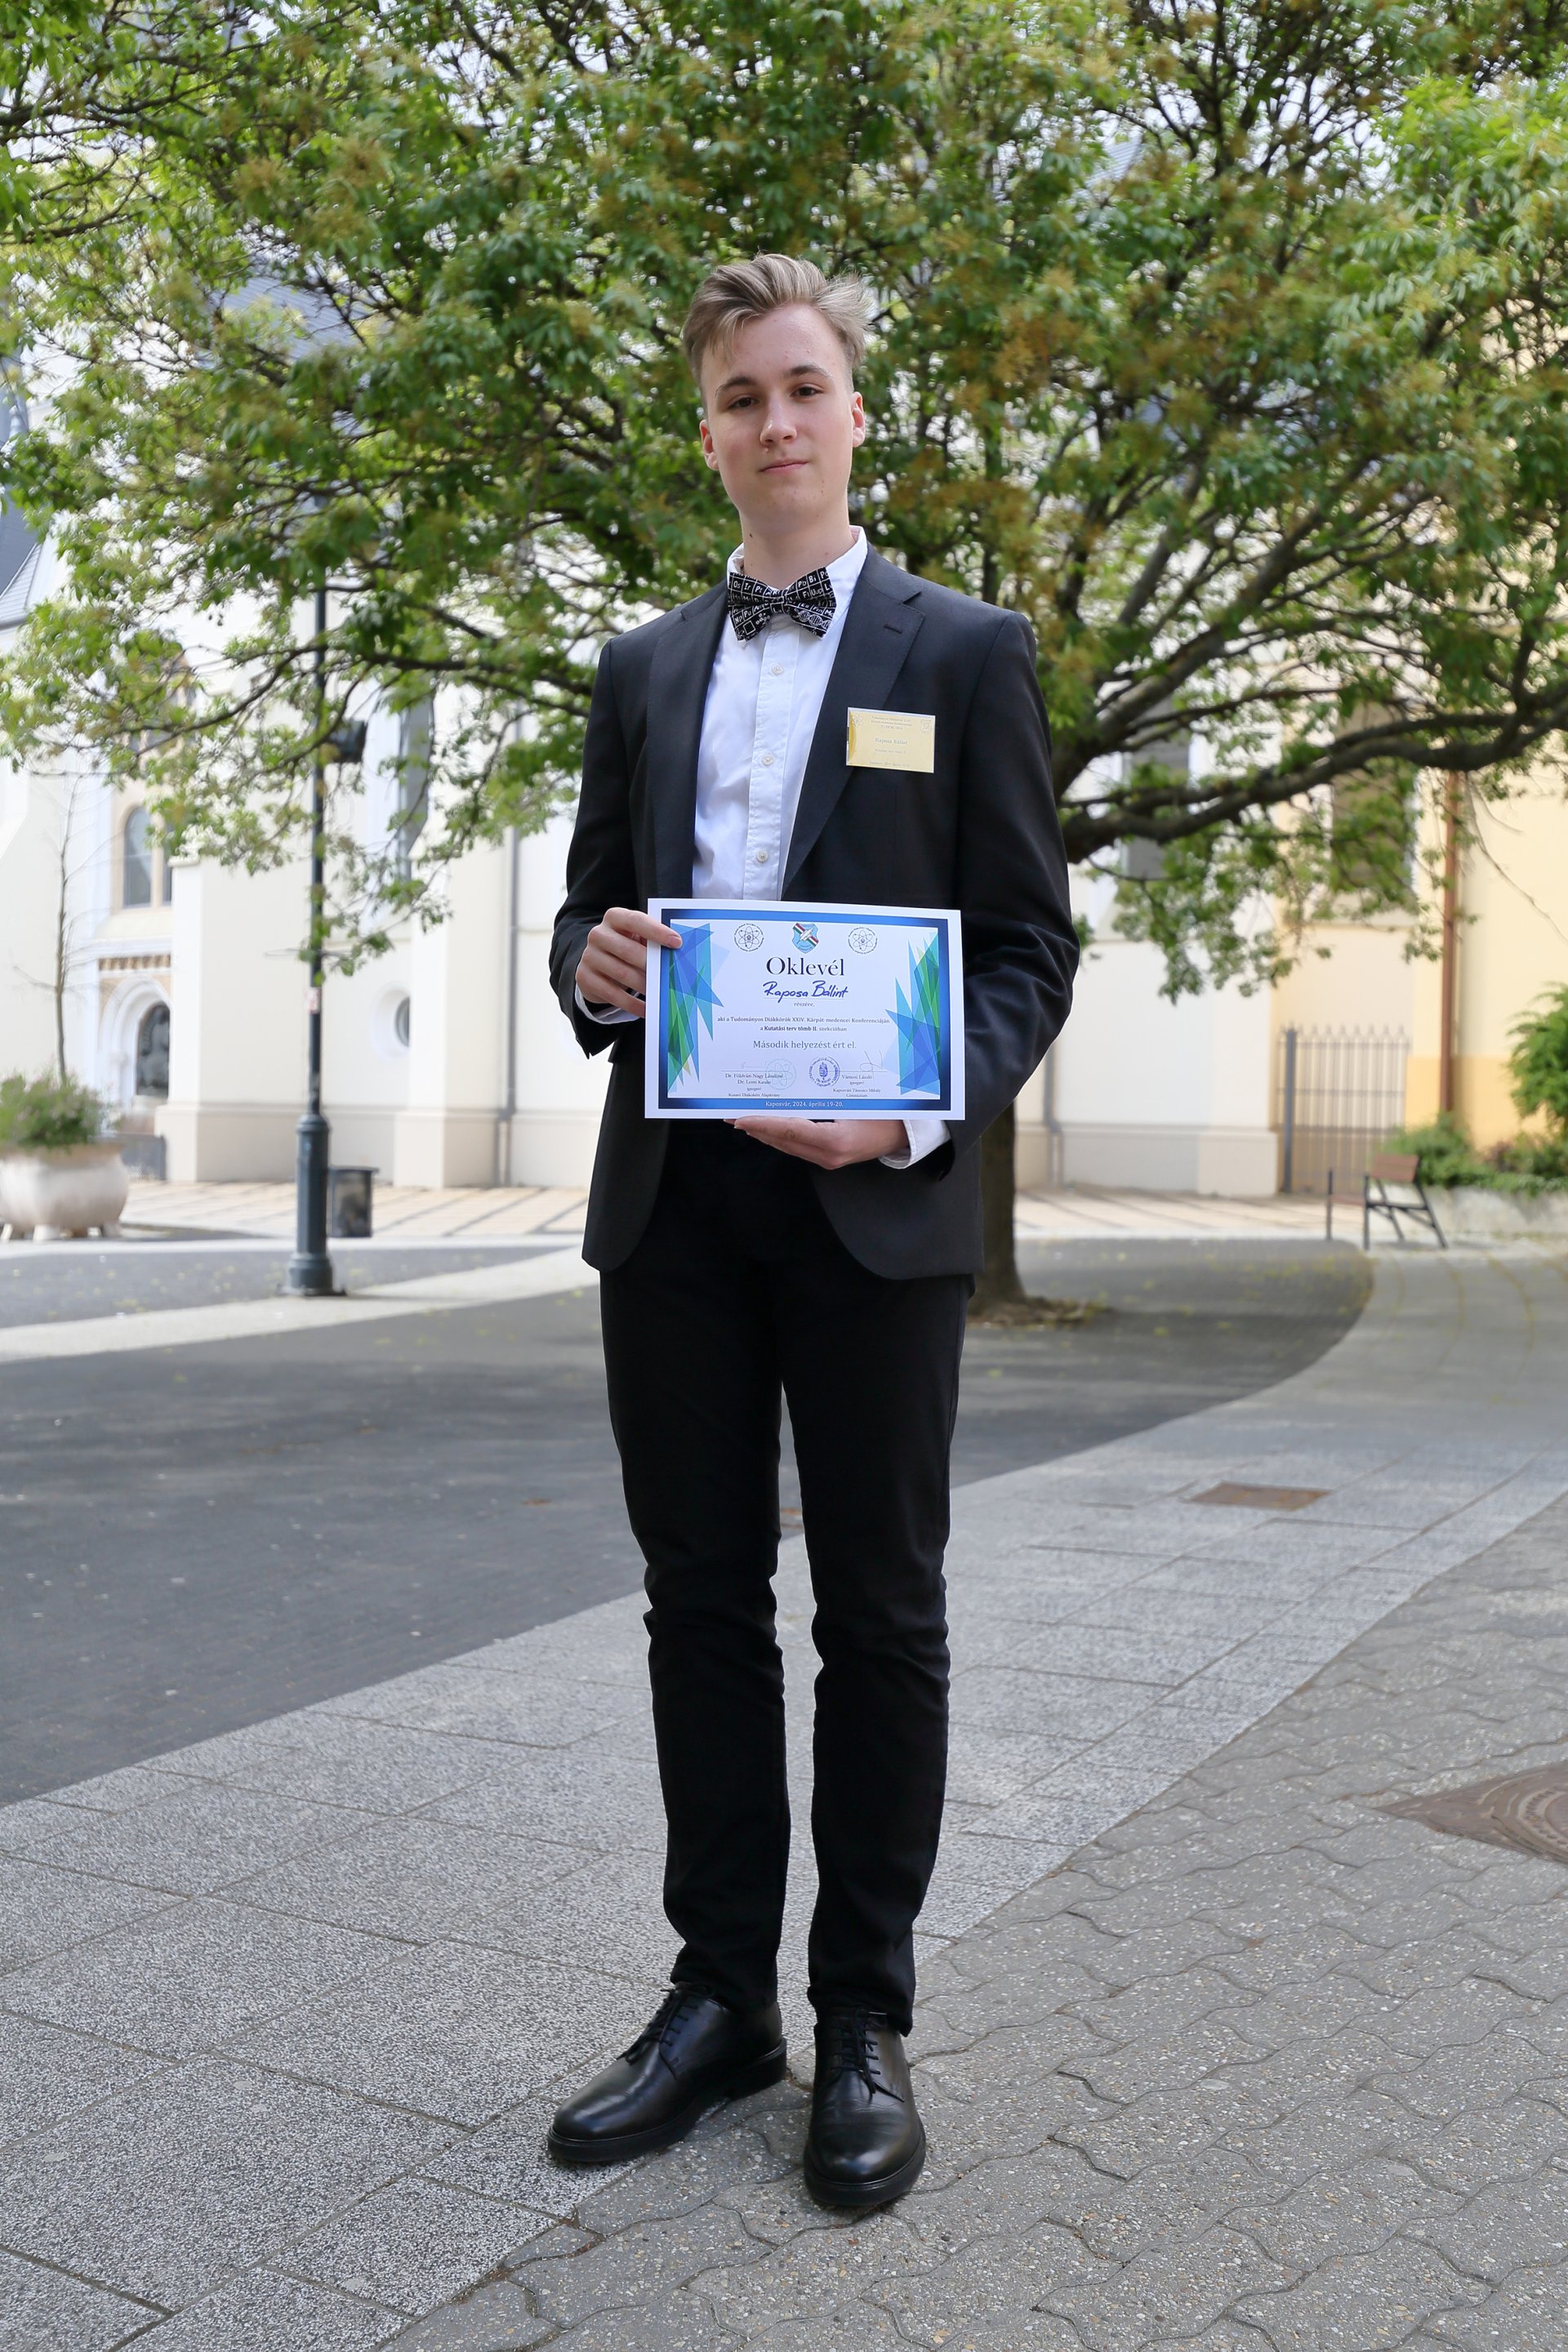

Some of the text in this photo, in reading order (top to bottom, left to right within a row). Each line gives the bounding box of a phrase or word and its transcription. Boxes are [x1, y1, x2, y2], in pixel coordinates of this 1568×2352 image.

[733, 580, 741, 588] Os
[808, 575, 817, 583] Bi
[766, 957, 844, 976] Oklevél
[763, 980, 849, 1003] Raposa Bálint
[753, 1040, 789, 1048] Második
[791, 1040, 831, 1050] helyezést
